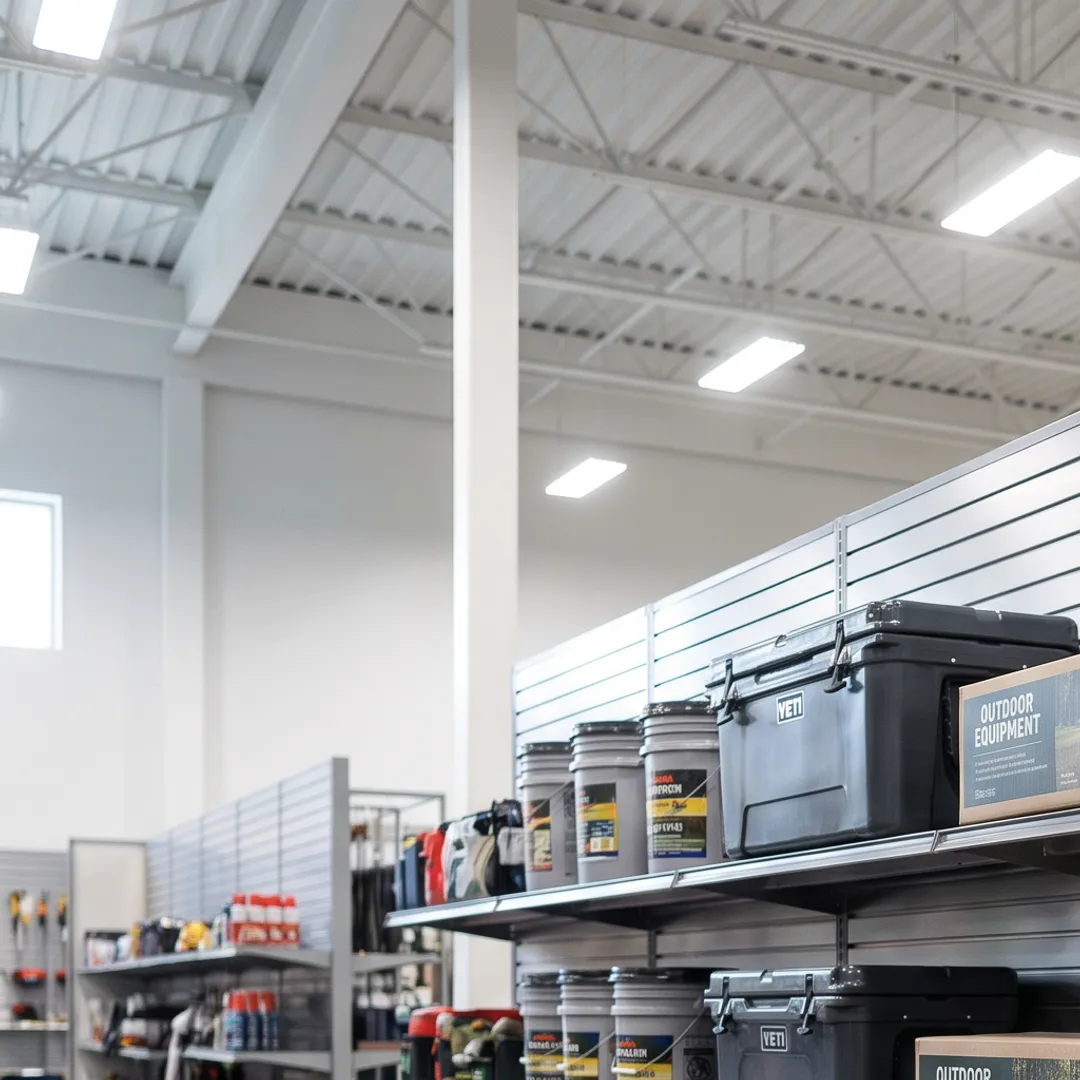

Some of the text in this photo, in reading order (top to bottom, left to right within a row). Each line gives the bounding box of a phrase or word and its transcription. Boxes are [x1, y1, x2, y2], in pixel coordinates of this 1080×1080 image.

[778, 696, 802, 720] YETI
[980, 692, 1034, 724] OUTDOOR
[974, 713, 1041, 748] EQUIPMENT
[763, 1031, 785, 1047] YETI
